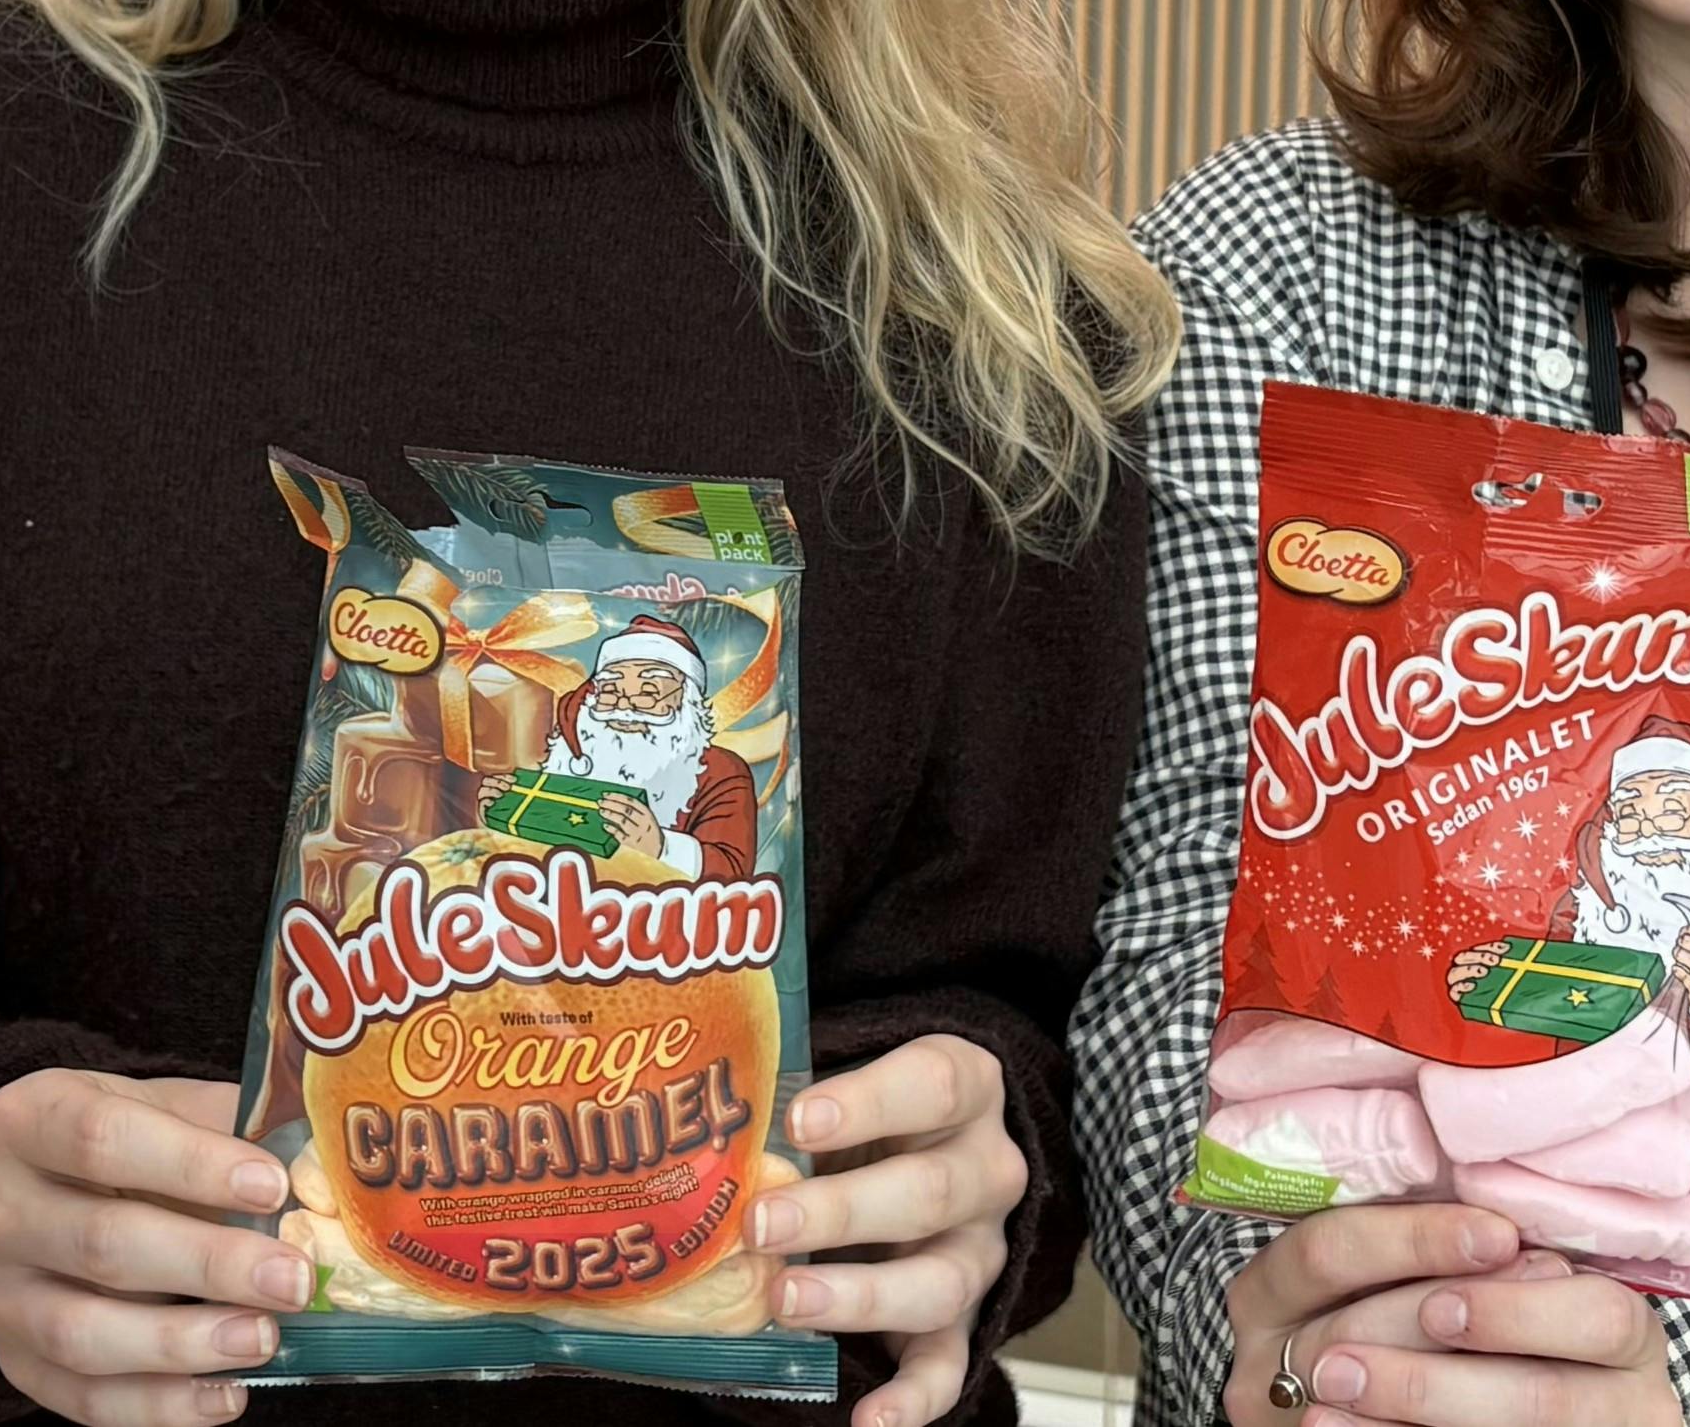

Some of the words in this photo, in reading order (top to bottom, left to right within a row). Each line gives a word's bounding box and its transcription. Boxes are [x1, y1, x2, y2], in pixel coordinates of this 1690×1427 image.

[719, 547, 766, 562] pack
[1276, 531, 1391, 587] Cloetta
[333, 602, 431, 661] Cloetta
[1355, 708, 1596, 844] ORIGINALET
[1425, 793, 1494, 846] Sedan
[1495, 765, 1550, 803] 1967
[282, 850, 782, 1049] JuleSkum
[499, 1011, 537, 1027] With
[539, 1011, 577, 1025] taste
[578, 1010, 594, 1024] of
[388, 999, 700, 1108] Orange
[343, 1060, 750, 1190] CARAMEL
[420, 1197, 456, 1212] With
[457, 1195, 507, 1208] orange
[508, 1187, 569, 1204] wrapped
[572, 1186, 586, 1197] in
[588, 1182, 643, 1195] caramel
[425, 1214, 454, 1227] this
[454, 1211, 502, 1225] festive
[505, 1208, 539, 1220] treat
[540, 1203, 566, 1216] will
[568, 1201, 605, 1214] make
[607, 1194, 659, 1211] Santa's
[660, 1177, 699, 1201] night!
[388, 1229, 478, 1283] LIMITED
[482, 1221, 667, 1291] 2025
